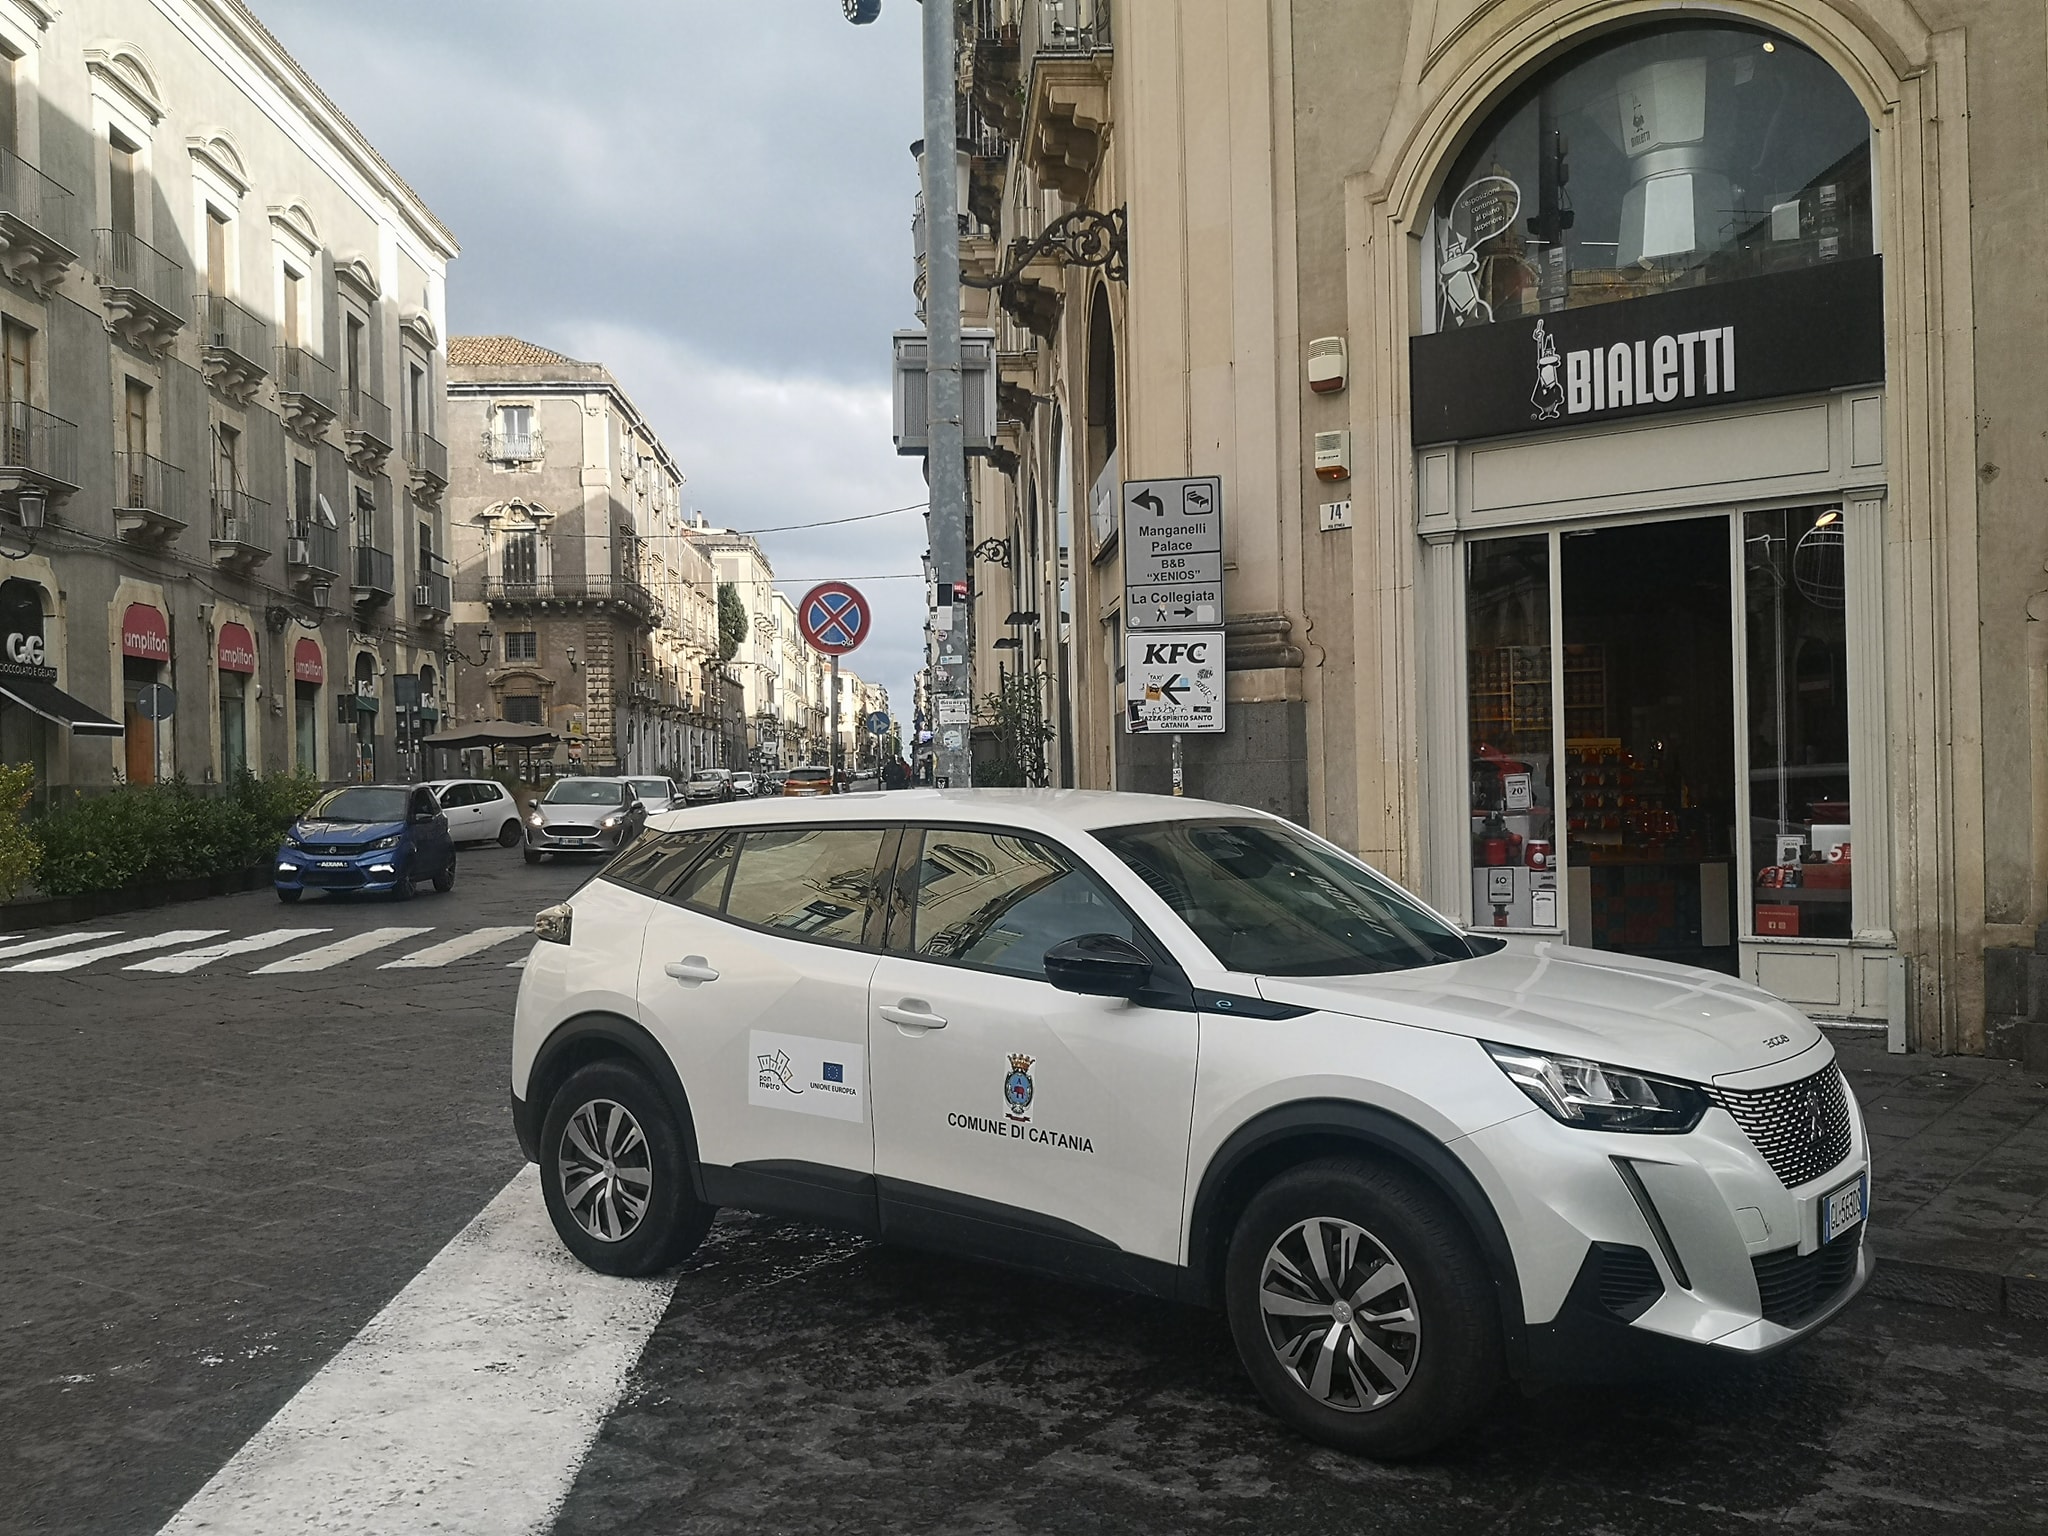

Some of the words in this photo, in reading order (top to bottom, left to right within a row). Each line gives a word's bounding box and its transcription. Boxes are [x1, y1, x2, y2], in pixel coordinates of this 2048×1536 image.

[1471, 198, 1499, 213] continua
[1482, 207, 1500, 219] piano
[1329, 503, 1342, 520] 74
[1139, 523, 1206, 538] Manganelli
[1152, 541, 1192, 552] Palace
[1161, 558, 1185, 569] B&B
[1132, 594, 1147, 604] La
[1151, 591, 1214, 604] Collegiata
[124, 631, 168, 654] amplifon
[220, 647, 254, 667] amplifon
[1143, 643, 1207, 664] KFC
[33, 667, 37, 676] E
[38, 668, 56, 678] GELATO
[296, 660, 322, 678] amplifon
[759, 1081, 780, 1091] metro
[810, 1082, 831, 1092] UNIONE
[831, 1083, 856, 1096] EUROPEA
[947, 1112, 1007, 1136] COMUNE
[1011, 1124, 1024, 1139] DI
[1029, 1128, 1094, 1153] CATANIA
